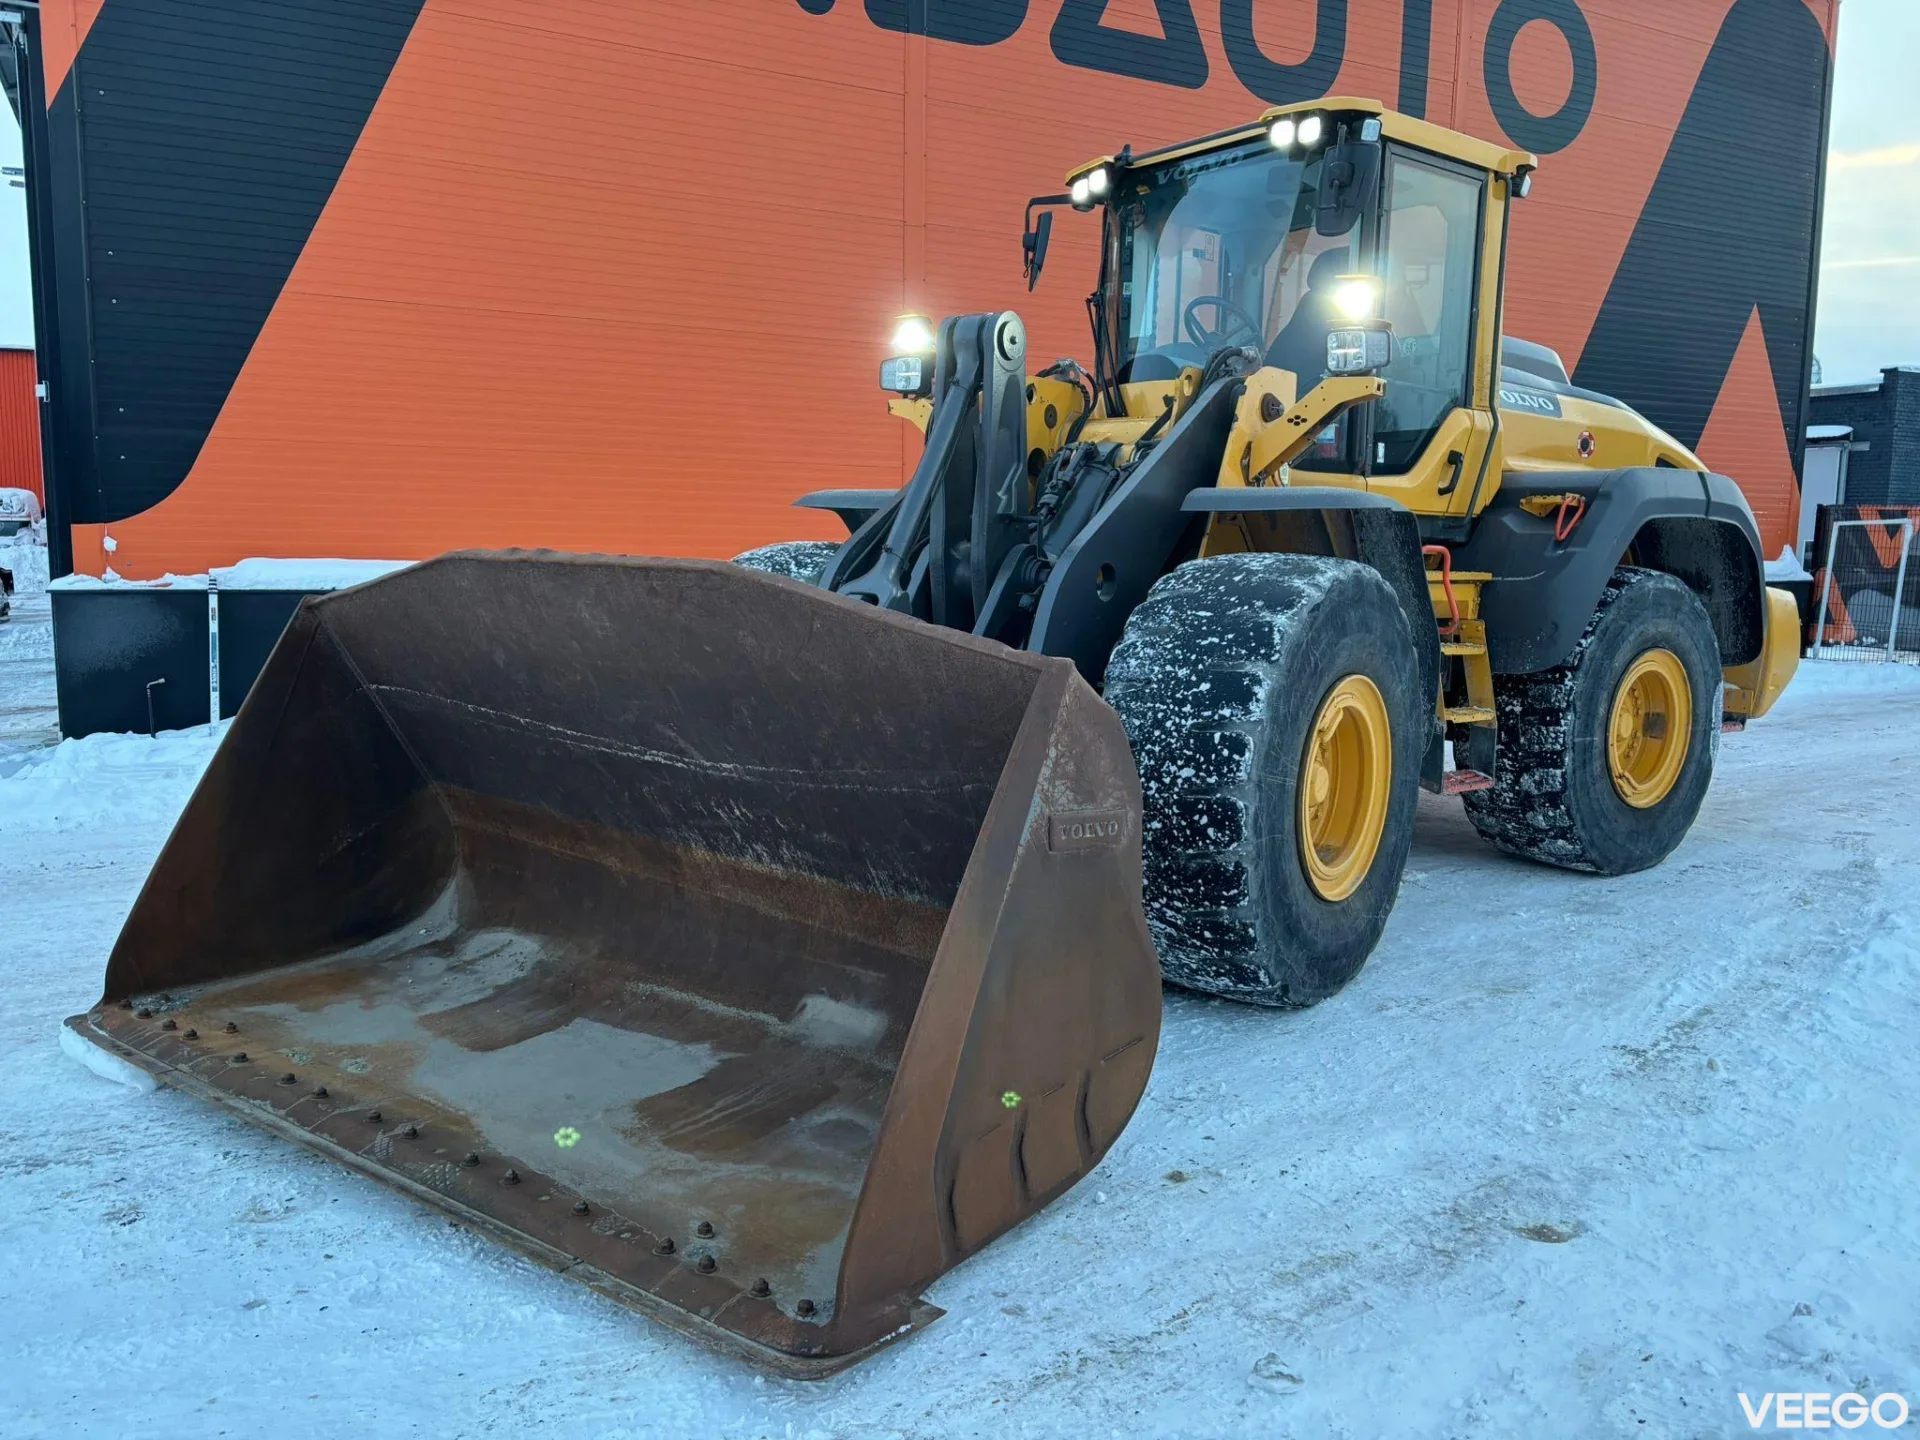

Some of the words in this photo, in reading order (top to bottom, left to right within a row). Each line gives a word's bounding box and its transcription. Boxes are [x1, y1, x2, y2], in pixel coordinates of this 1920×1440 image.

[1155, 150, 1244, 184] VOLVO
[1499, 390, 1554, 410] OLVO
[1060, 821, 1118, 840] VOLVO
